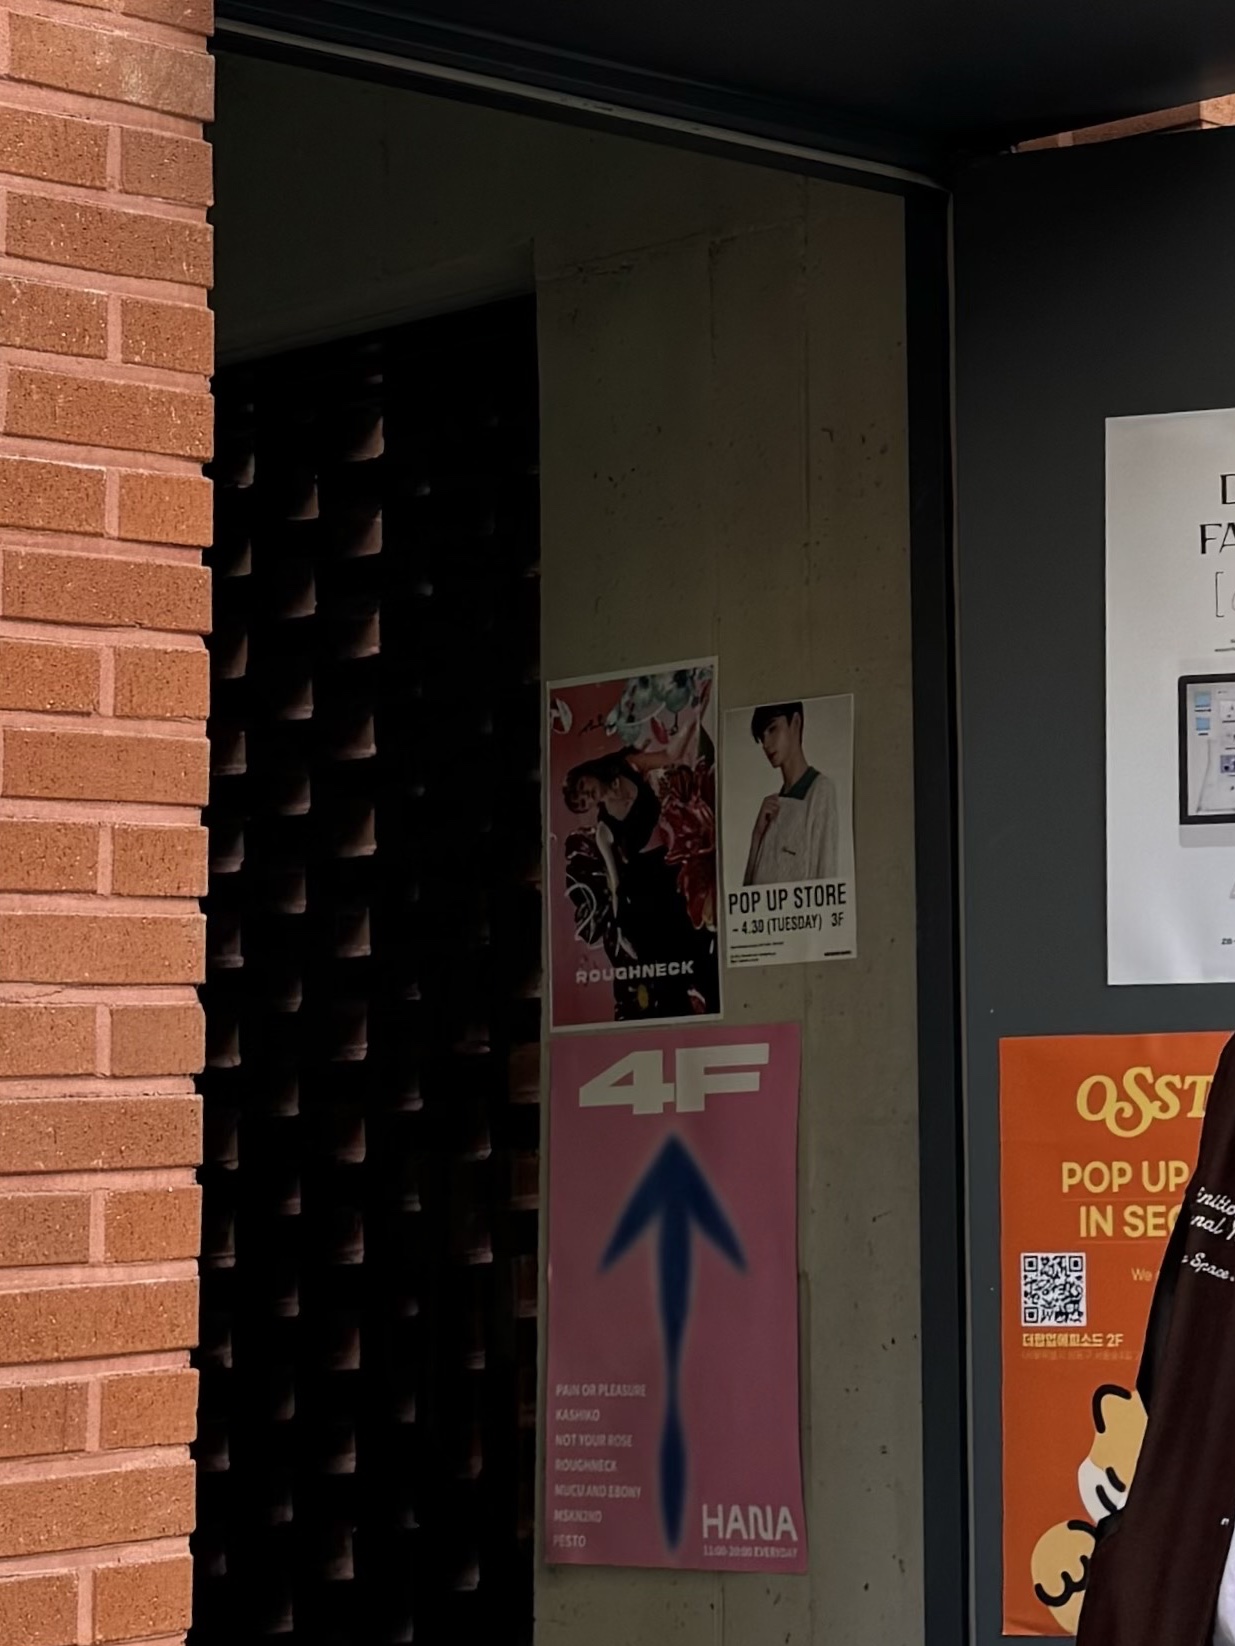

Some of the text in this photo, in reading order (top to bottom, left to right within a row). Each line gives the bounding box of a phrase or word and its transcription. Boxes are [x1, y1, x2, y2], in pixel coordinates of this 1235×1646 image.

[728, 883, 846, 915] POP UP STORE
[742, 920, 764, 934] 4.30
[767, 914, 822, 935] (TUESDAY)
[831, 912, 844, 927] 3F
[575, 960, 695, 984] ROUGHNECK
[579, 1042, 770, 1115] 4F
[1061, 1160, 1190, 1194] POP UP
[1079, 1205, 1114, 1238] IN
[1105, 1332, 1124, 1348] 2F
[556, 1383, 647, 1398] PAIN OR PLEASURE
[555, 1433, 634, 1448] NOT YOUR ROSE
[554, 1458, 619, 1473] ROUGHNECK
[702, 1503, 799, 1542] HANA
[552, 1534, 587, 1549] PESTO
